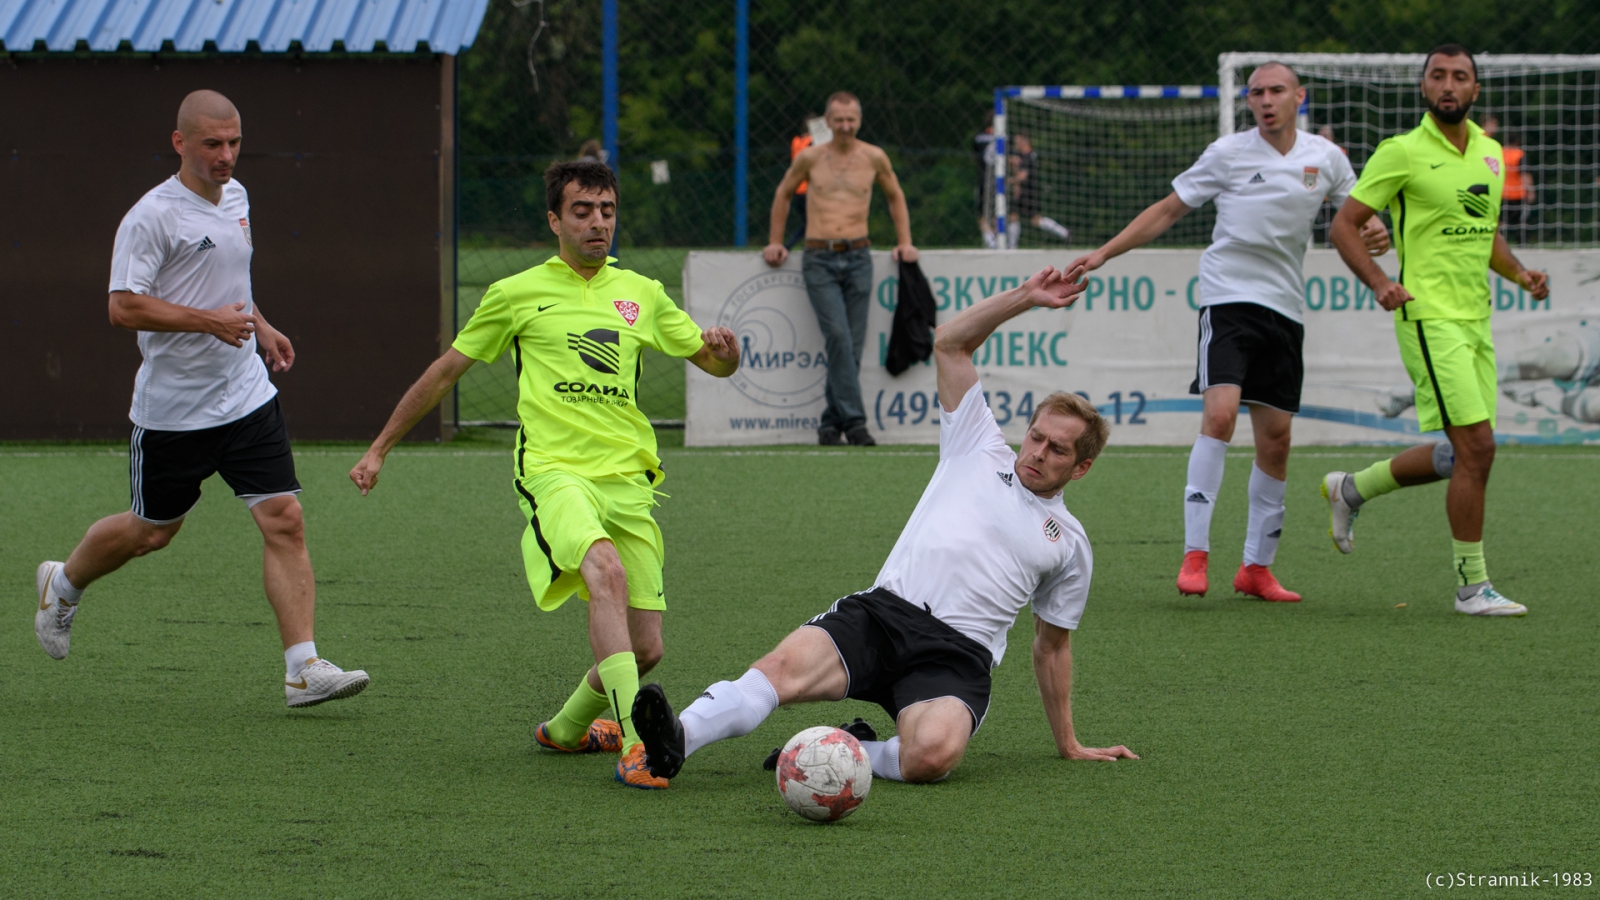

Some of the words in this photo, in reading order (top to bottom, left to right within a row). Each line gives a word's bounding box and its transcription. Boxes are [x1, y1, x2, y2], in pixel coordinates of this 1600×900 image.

[731, 275, 807, 310] ГОСУДАРСТВ
[740, 336, 828, 368] МИРЭА
[879, 331, 1067, 367] ЛЕКС
[553, 381, 630, 399] СОЛИД
[729, 413, 821, 430] www.mirea.
